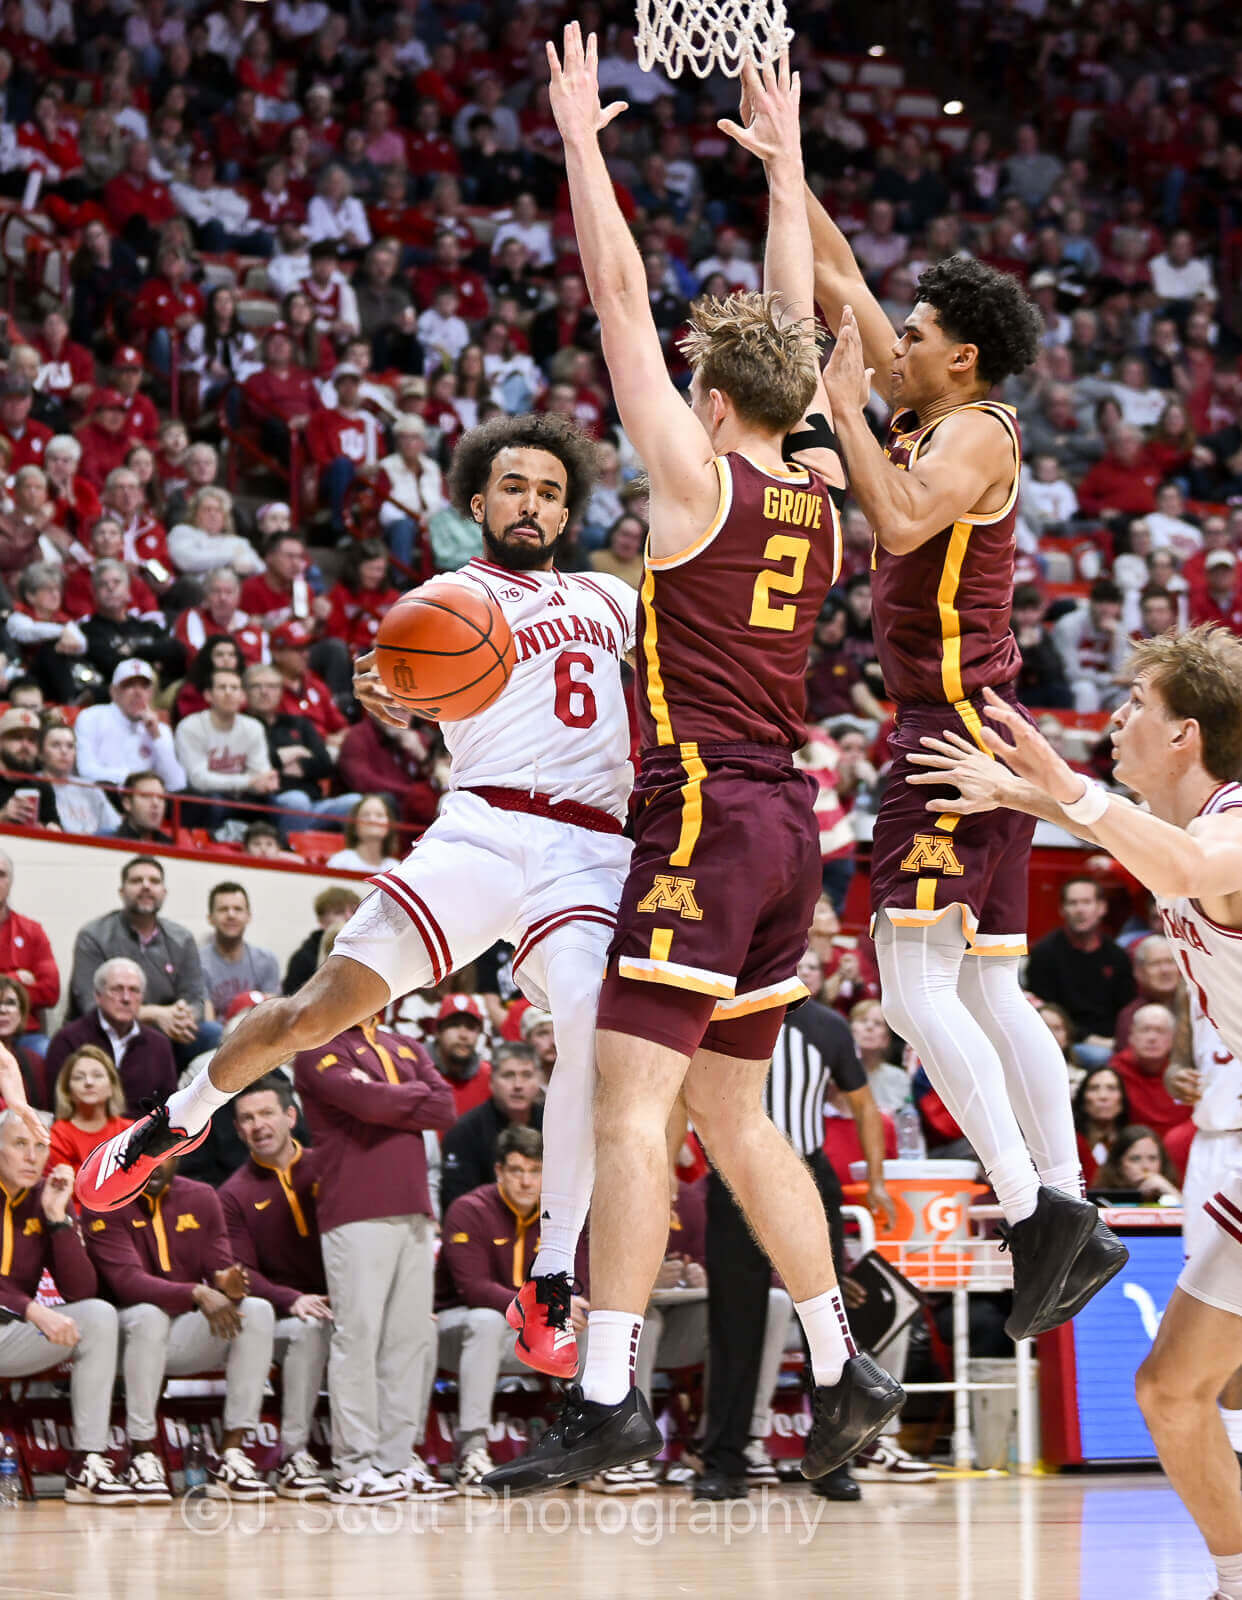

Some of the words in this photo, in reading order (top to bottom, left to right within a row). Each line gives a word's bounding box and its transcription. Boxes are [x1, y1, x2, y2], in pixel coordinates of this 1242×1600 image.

[763, 486, 823, 529] GROVE
[501, 587, 519, 599] 76
[749, 534, 811, 632] 2
[554, 651, 597, 729] 6
[901, 833, 964, 876] M
[637, 874, 703, 920] M
[928, 1198, 959, 1231] G
